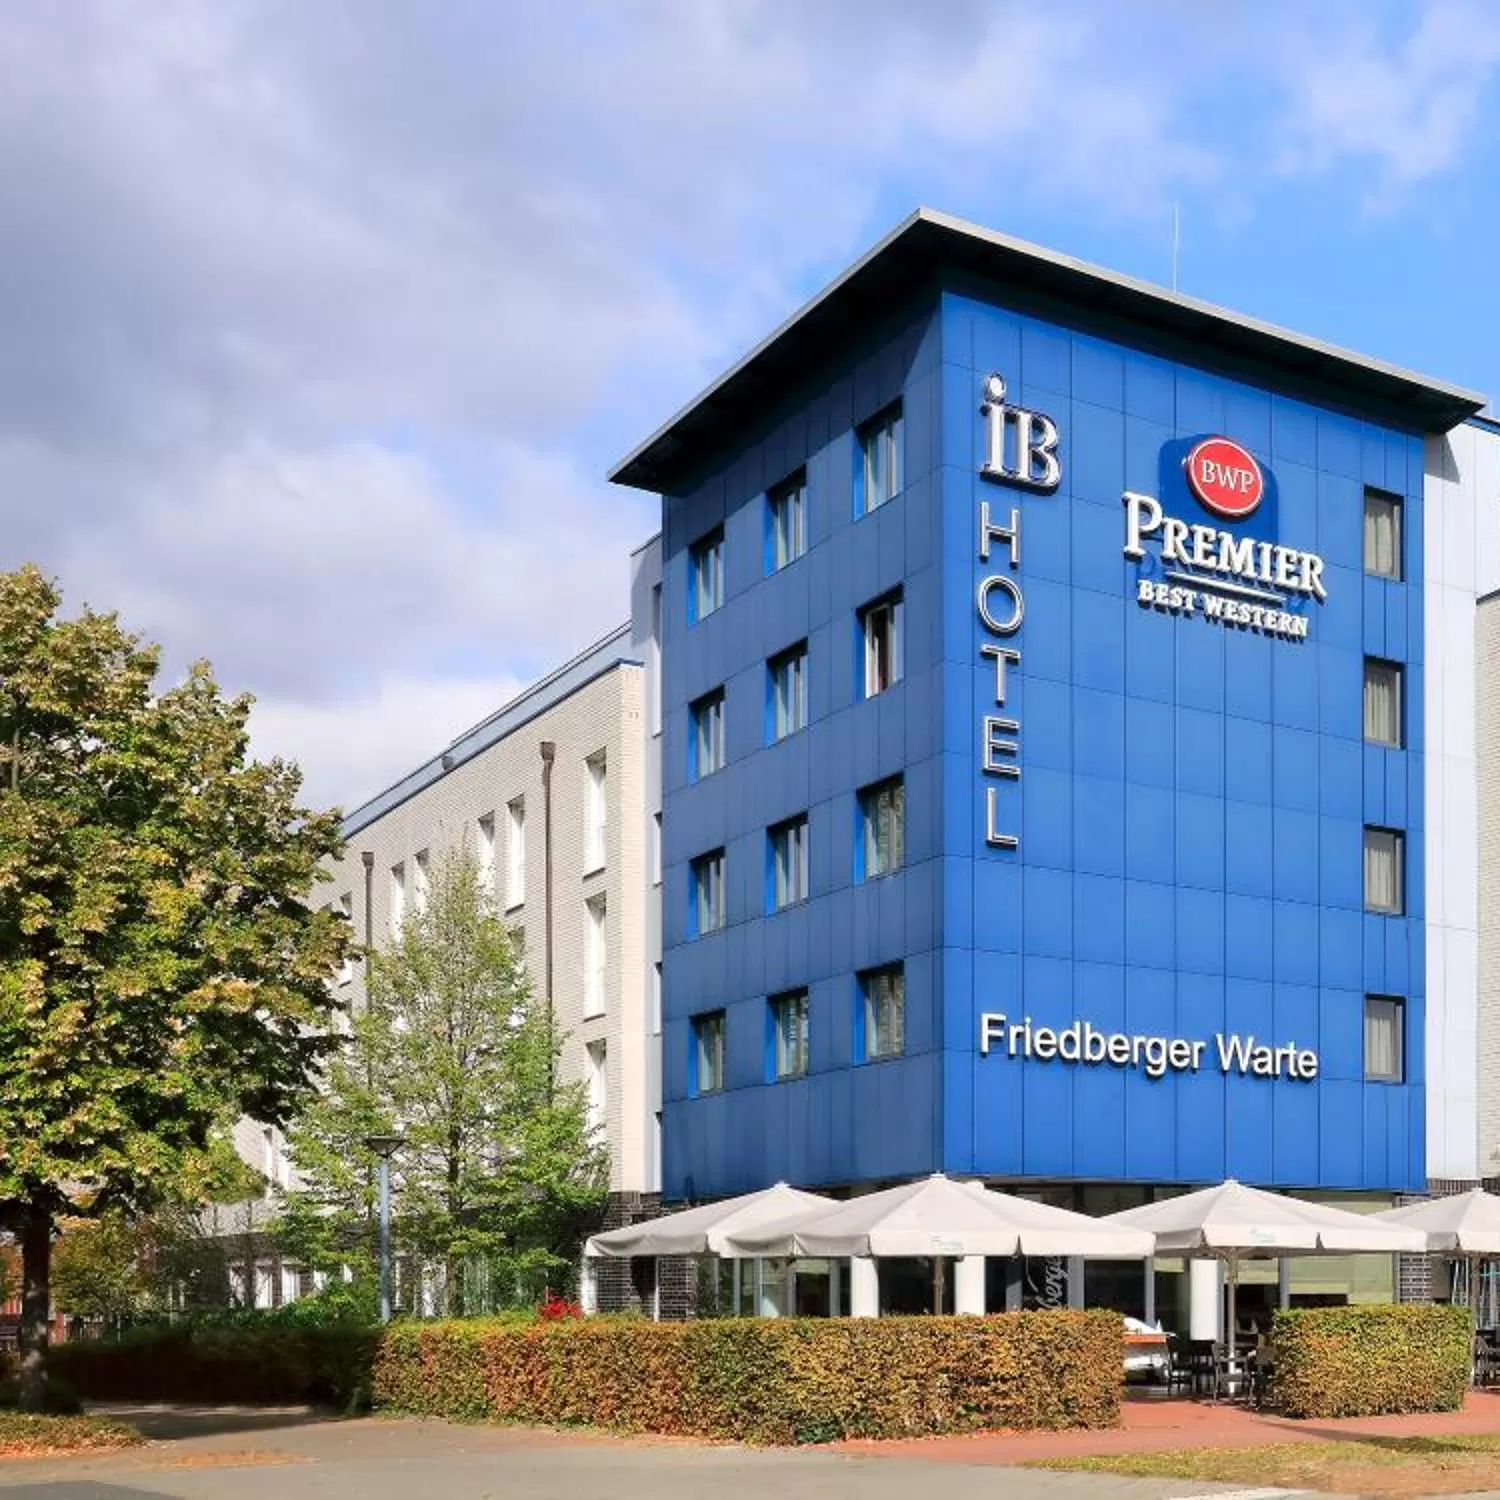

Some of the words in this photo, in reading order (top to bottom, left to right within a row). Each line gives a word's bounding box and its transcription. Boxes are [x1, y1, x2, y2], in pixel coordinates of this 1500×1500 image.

[1201, 459, 1254, 493] BWP
[1122, 491, 1328, 600] PREMIER
[1138, 579, 1197, 613] BEST
[1203, 595, 1310, 637] WESTERN
[978, 501, 1024, 847] HOTEL
[981, 1012, 1205, 1078] Friedberger
[1216, 1033, 1318, 1079] Warte
